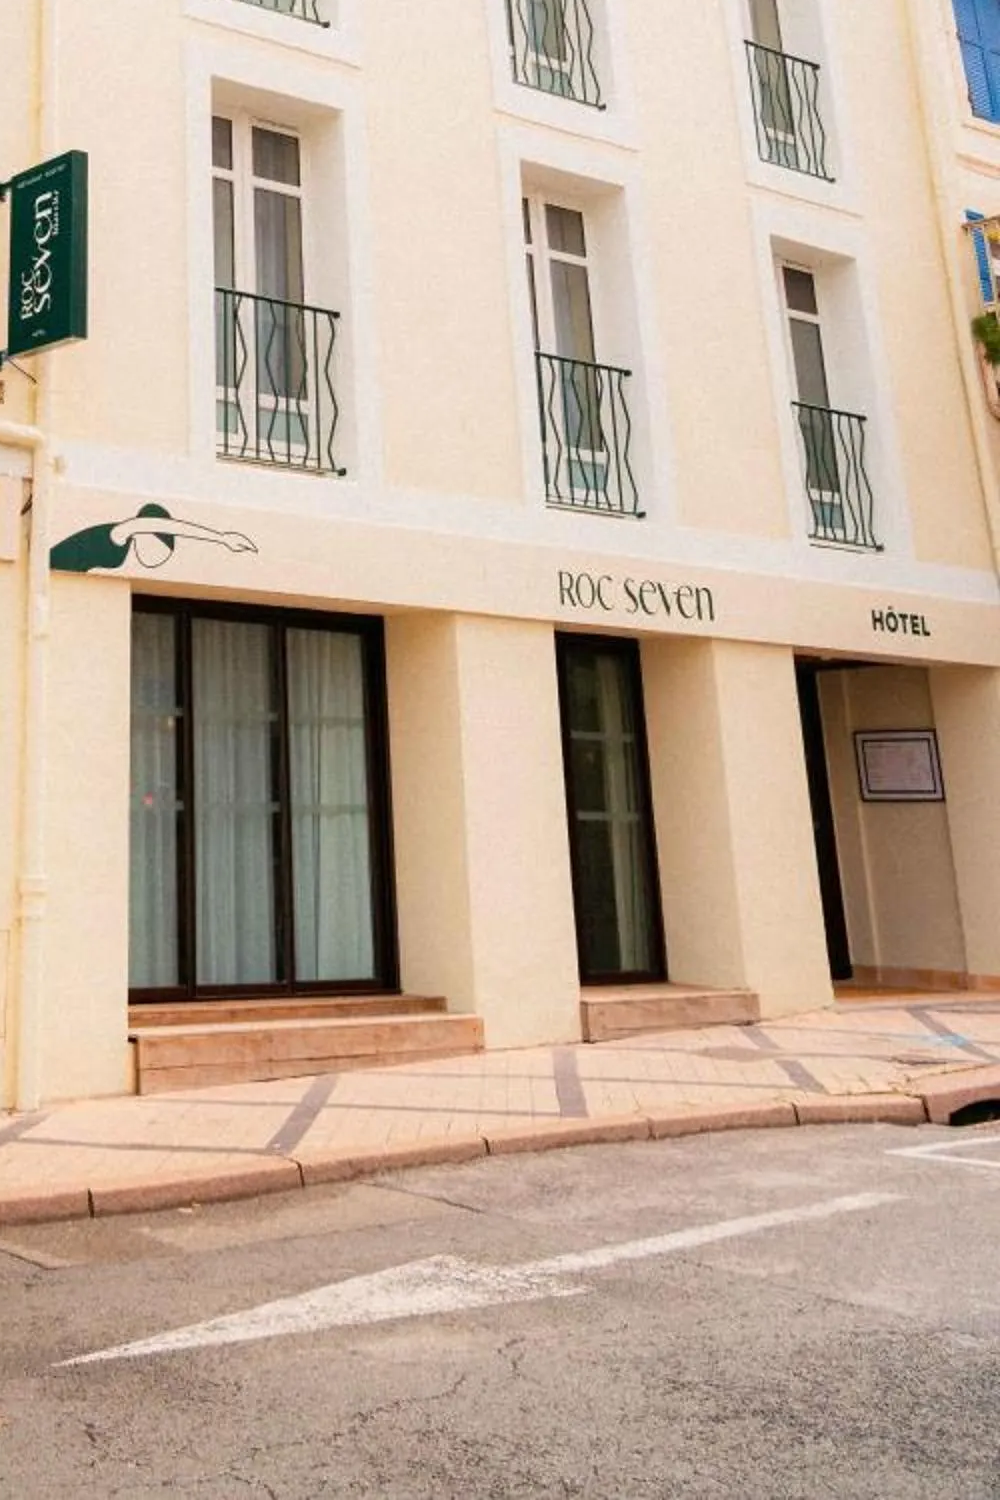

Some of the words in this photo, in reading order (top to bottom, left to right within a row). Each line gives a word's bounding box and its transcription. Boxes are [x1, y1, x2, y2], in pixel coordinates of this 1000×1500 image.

[32, 190, 54, 313] seven
[20, 271, 35, 320] ROC
[557, 570, 614, 611] ROC
[622, 576, 716, 622] seven
[871, 605, 931, 637] HÔTEL
